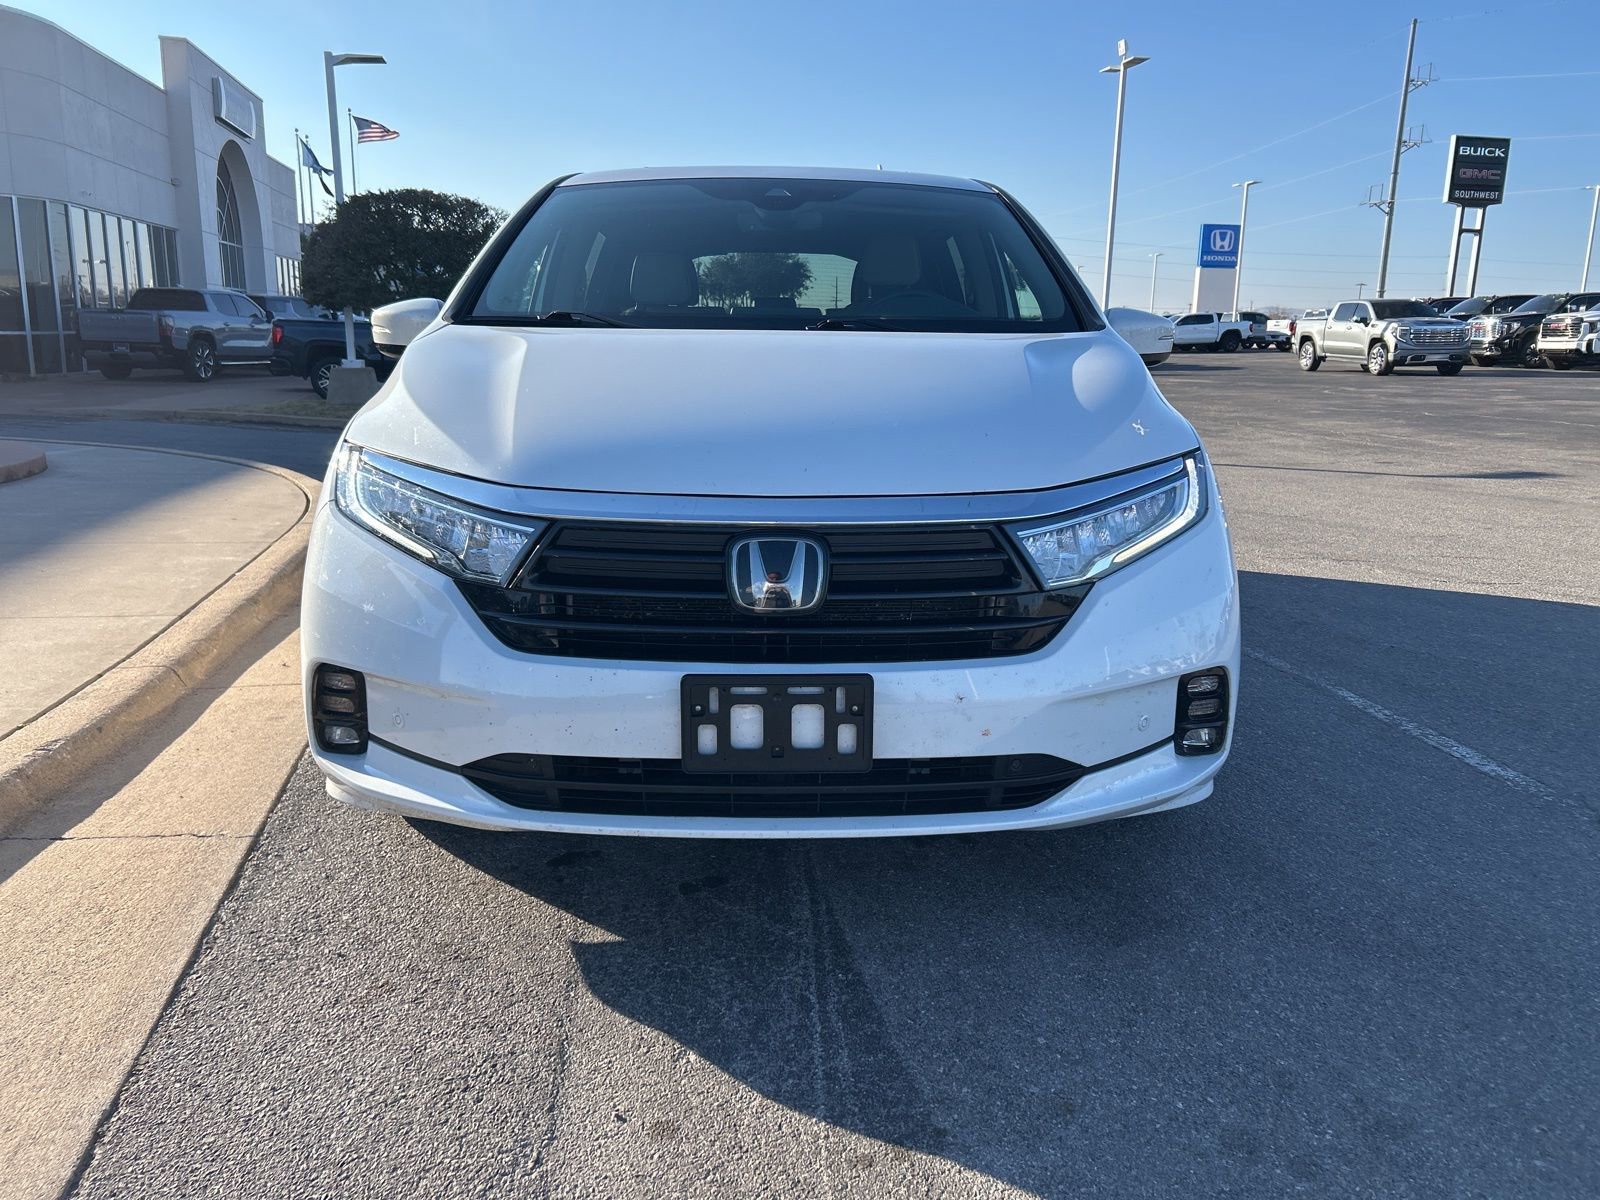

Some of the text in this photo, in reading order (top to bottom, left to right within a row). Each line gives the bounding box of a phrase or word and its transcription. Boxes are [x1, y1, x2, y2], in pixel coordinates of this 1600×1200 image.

[1459, 146, 1506, 157] BUICK
[1459, 168, 1501, 179] GMC
[1455, 190, 1499, 199] SOUTHWEST
